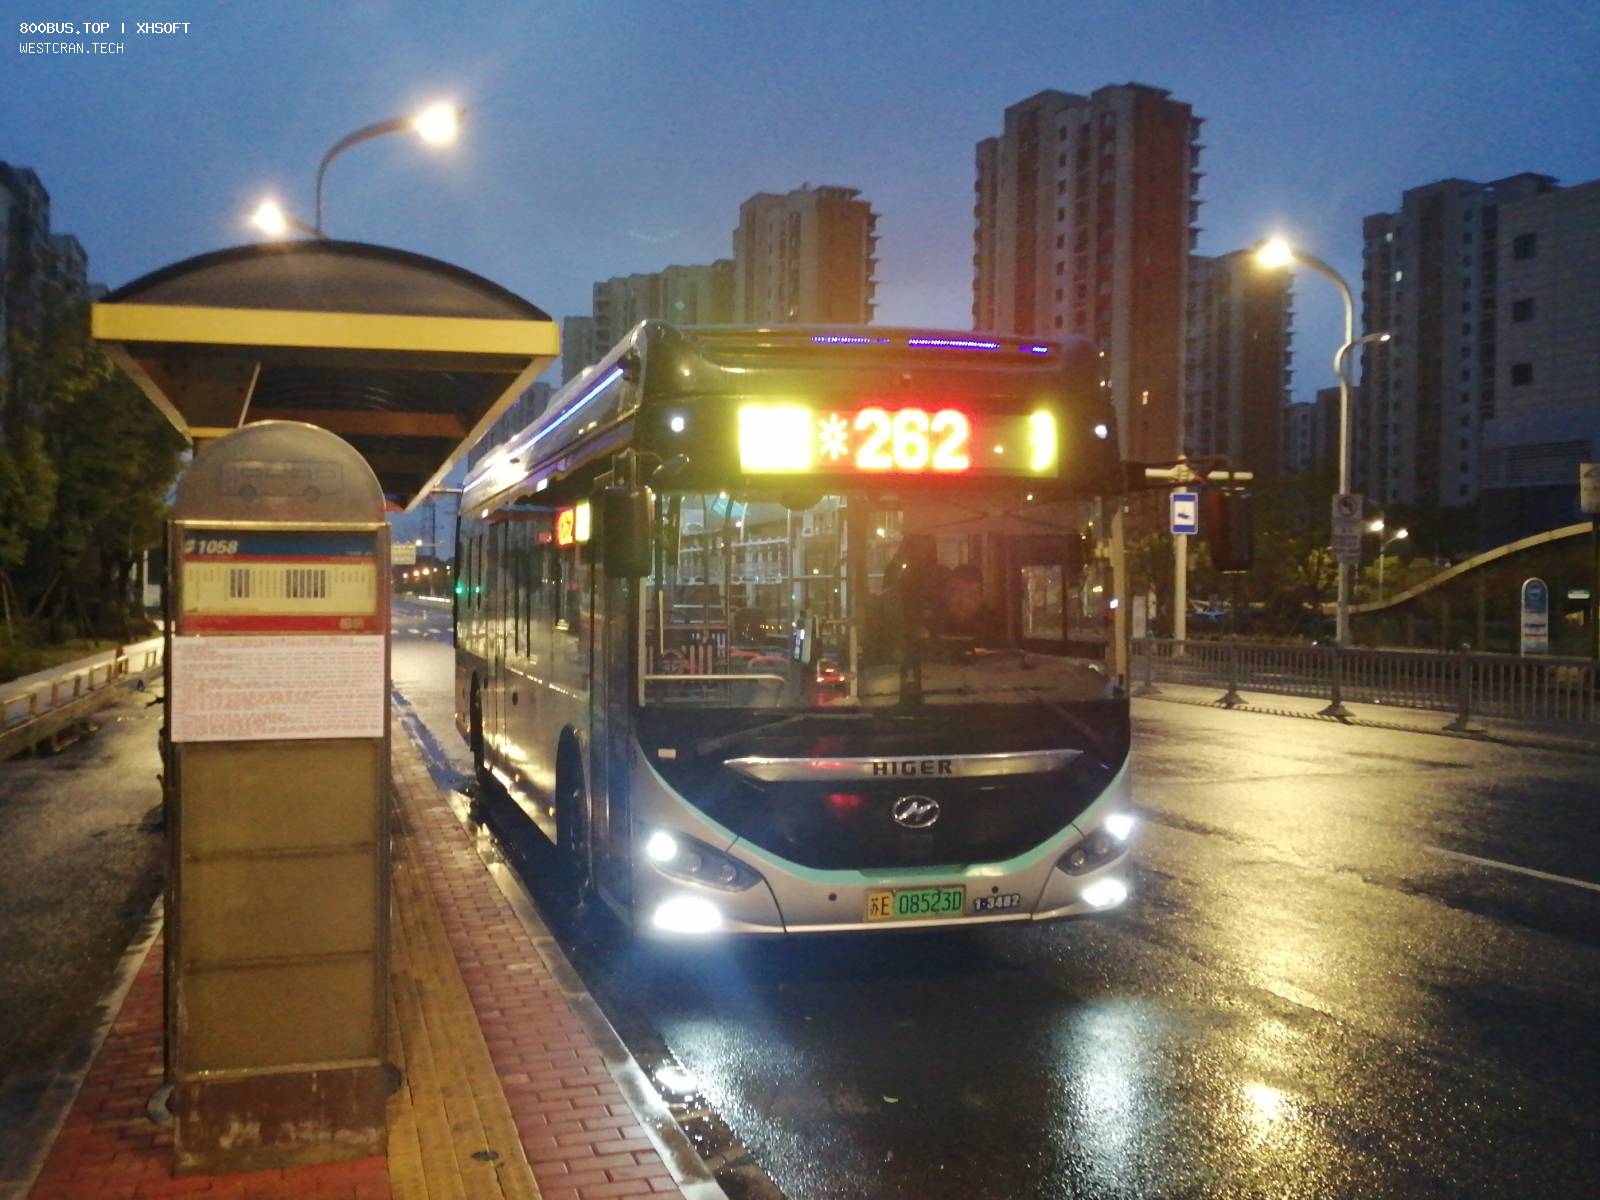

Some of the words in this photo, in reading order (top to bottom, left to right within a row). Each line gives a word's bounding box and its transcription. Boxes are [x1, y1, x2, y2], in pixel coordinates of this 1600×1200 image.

[853, 406, 970, 473] 262
[872, 760, 952, 776] HIGER
[899, 891, 962, 914] 08523D
